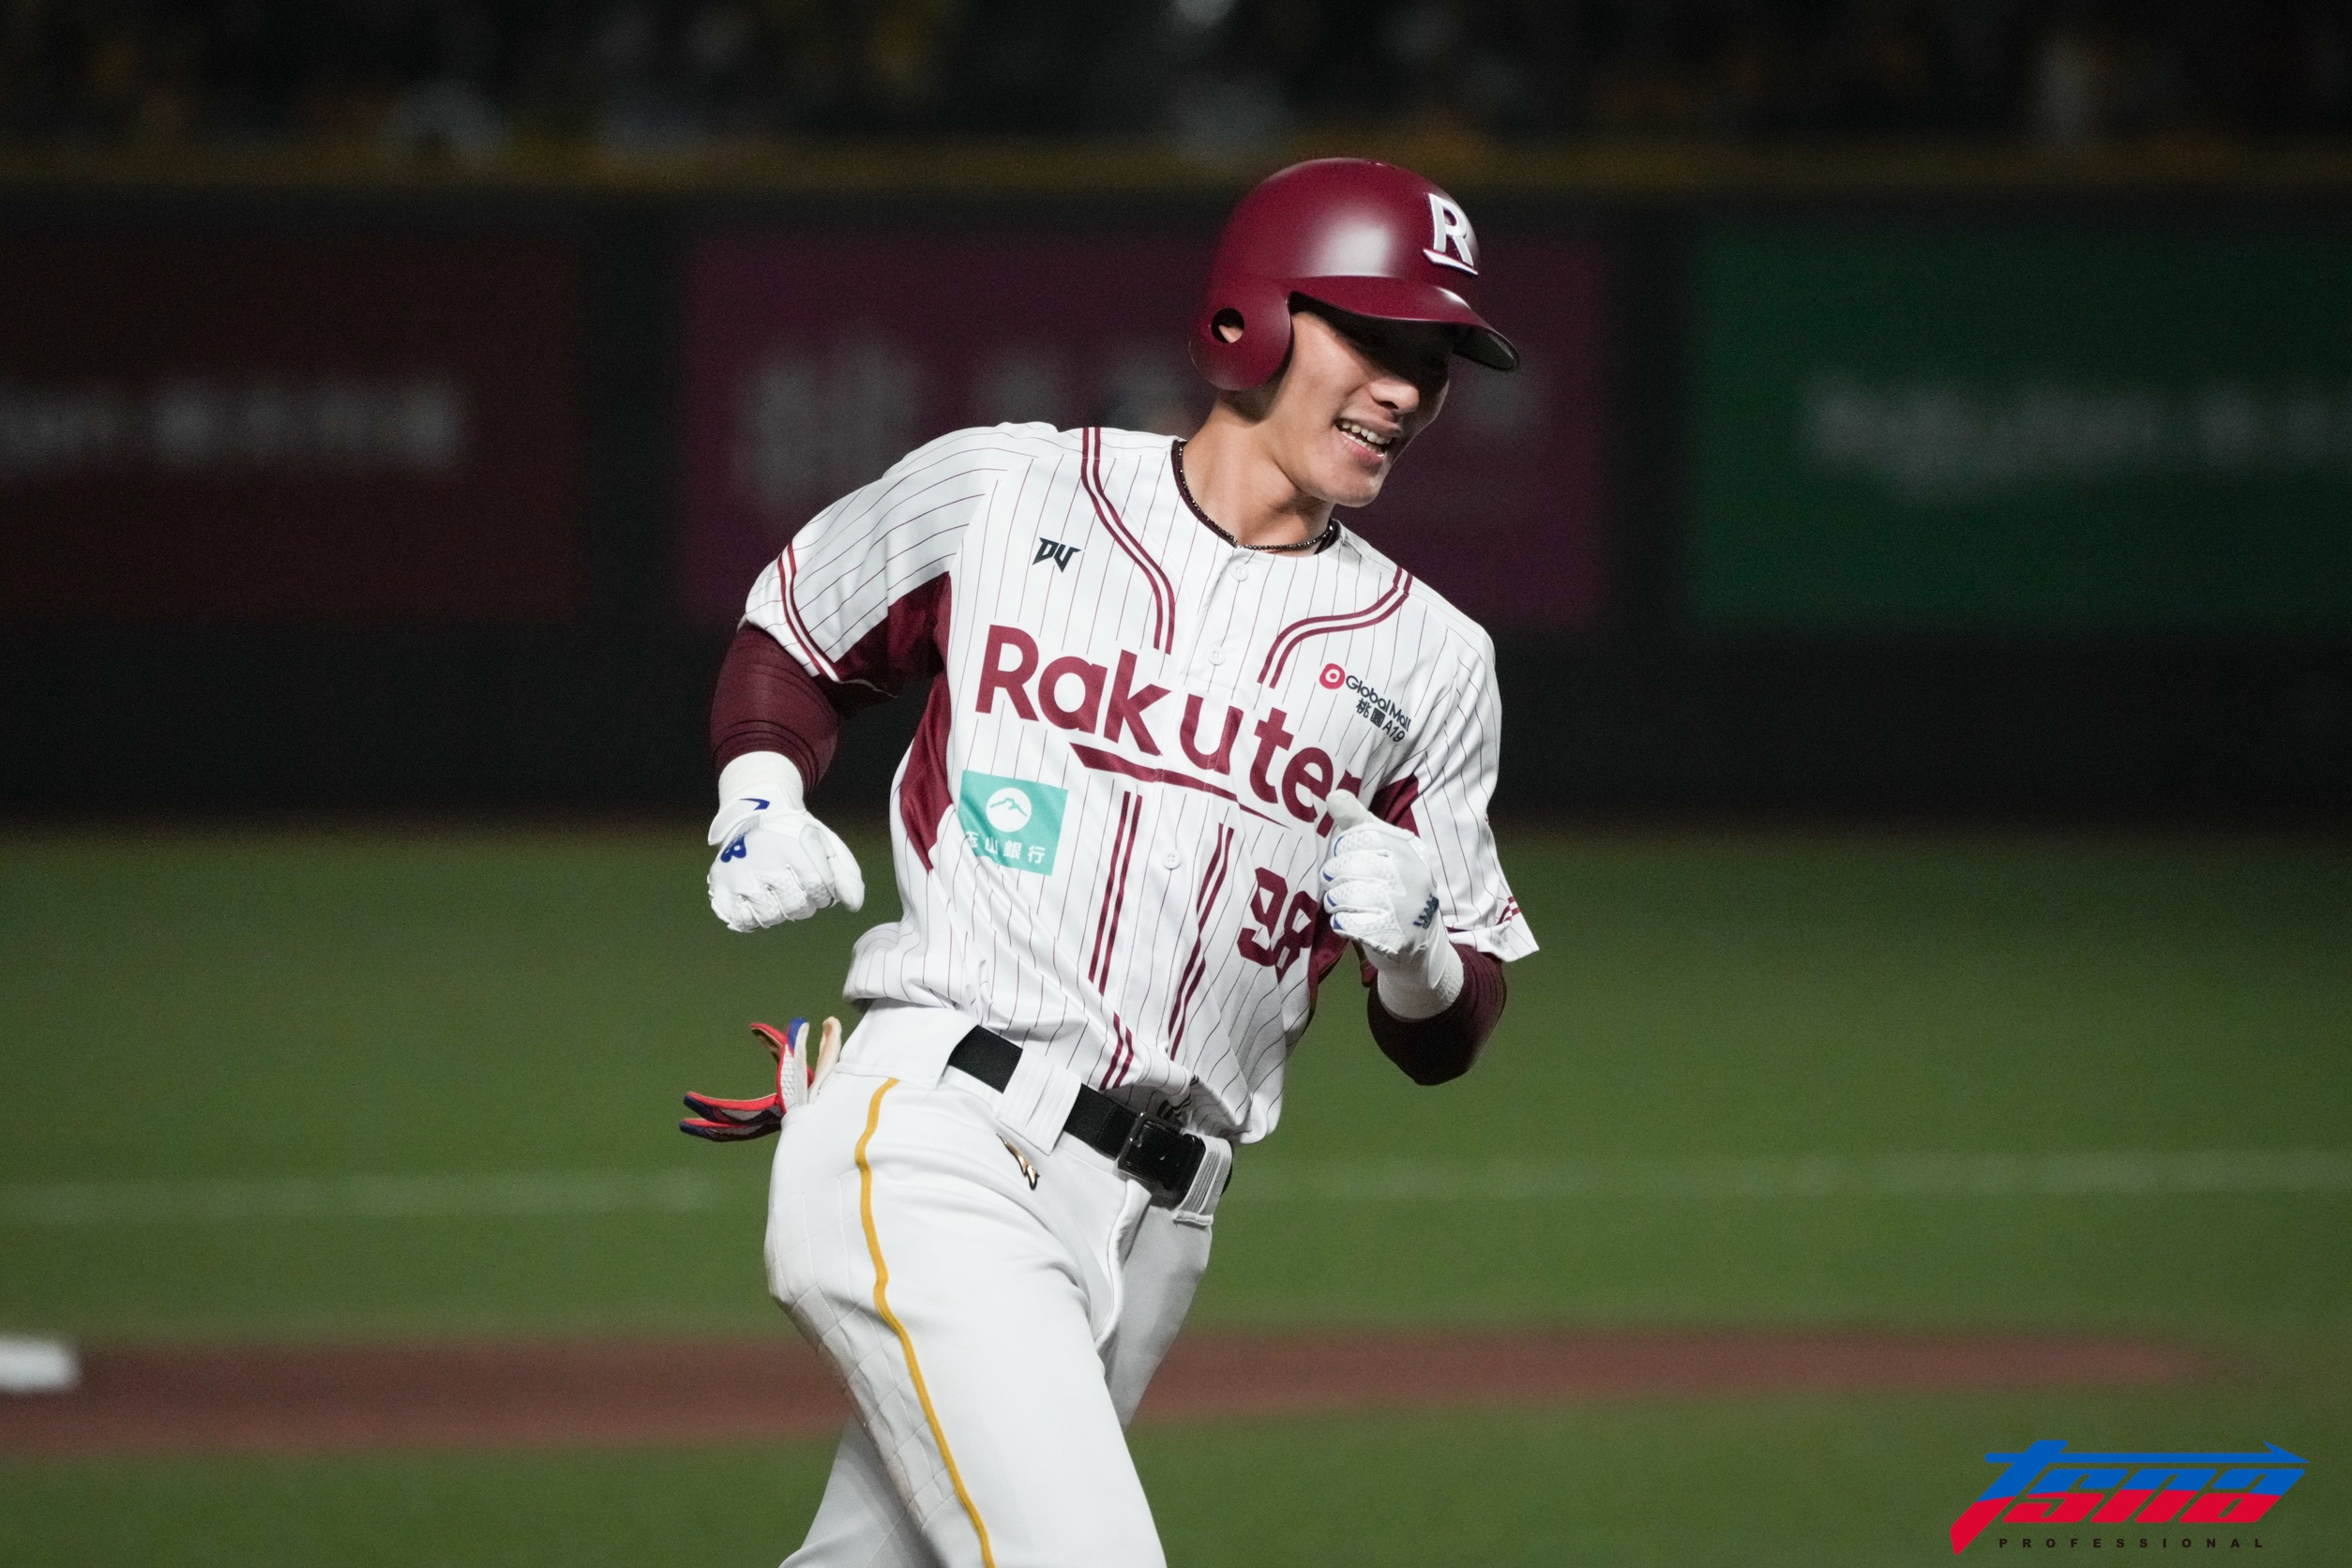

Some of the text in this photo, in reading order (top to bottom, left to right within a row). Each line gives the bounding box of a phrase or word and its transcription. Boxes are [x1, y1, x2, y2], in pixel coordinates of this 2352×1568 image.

[1427, 193, 1474, 268] R
[1346, 675, 1411, 732] Global Mall
[1381, 719, 1406, 742] A19
[1237, 867, 1318, 984] 98
